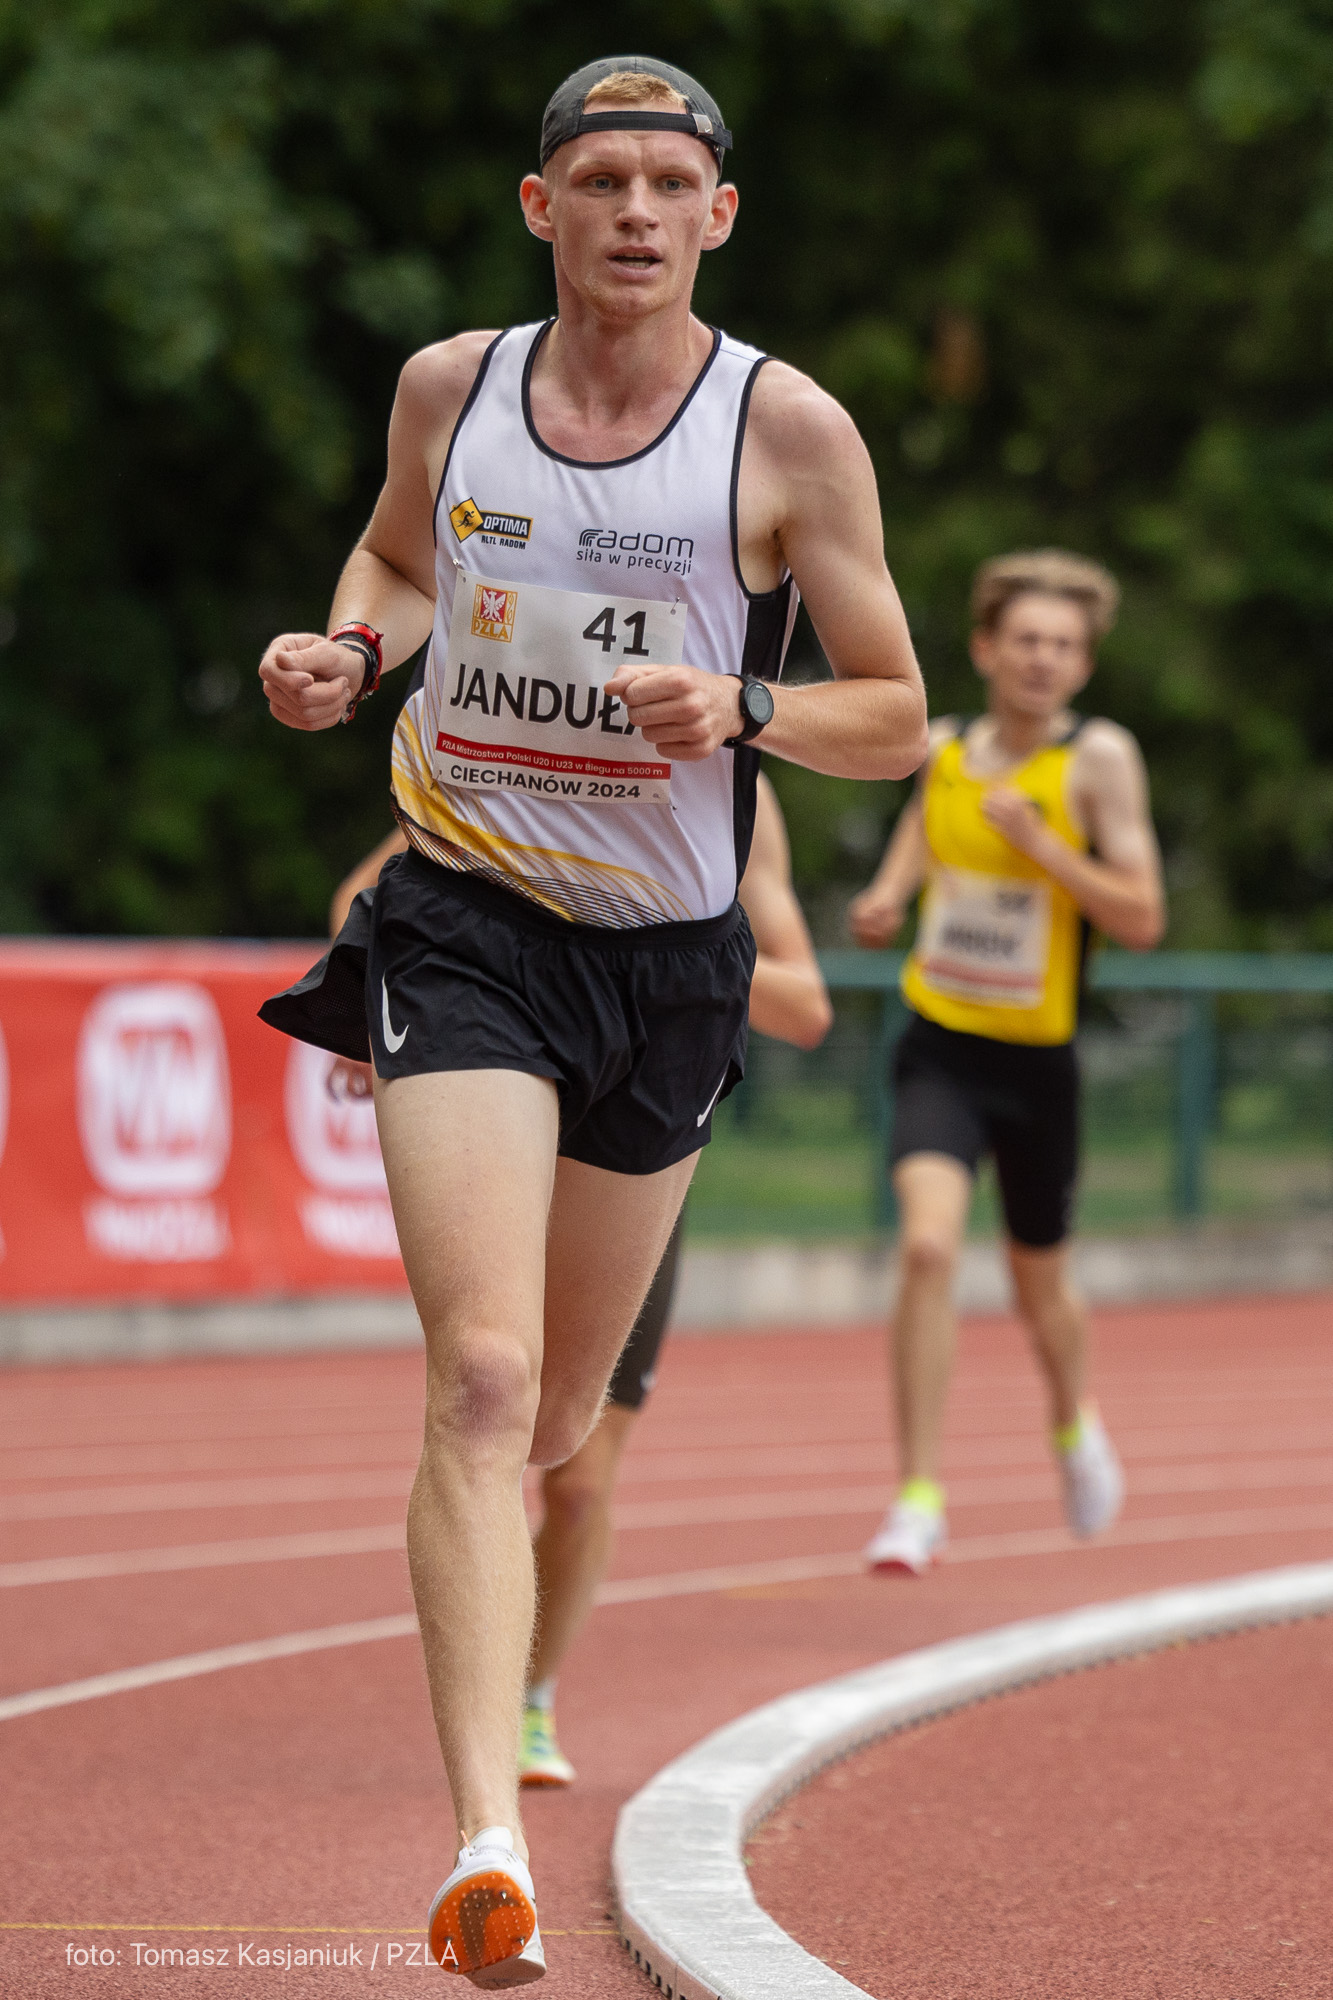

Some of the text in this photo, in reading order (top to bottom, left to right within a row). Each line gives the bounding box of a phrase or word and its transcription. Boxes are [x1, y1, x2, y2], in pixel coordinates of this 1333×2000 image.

[483, 515, 528, 536] OPTIMA
[499, 538, 526, 550] RADOM
[576, 549, 692, 576] siła w precyzji
[473, 619, 509, 640] PZLA
[582, 607, 650, 656] 41
[450, 663, 642, 735] JANDUŁ
[442, 740, 456, 751] PZLA
[456, 745, 504, 760] Mistrzostwa
[506, 752, 532, 763] Polski
[533, 758, 550, 767] U20
[556, 761, 574, 770] U23
[627, 767, 651, 775] 5000
[450, 765, 640, 798] CIECHANÓW 2024
